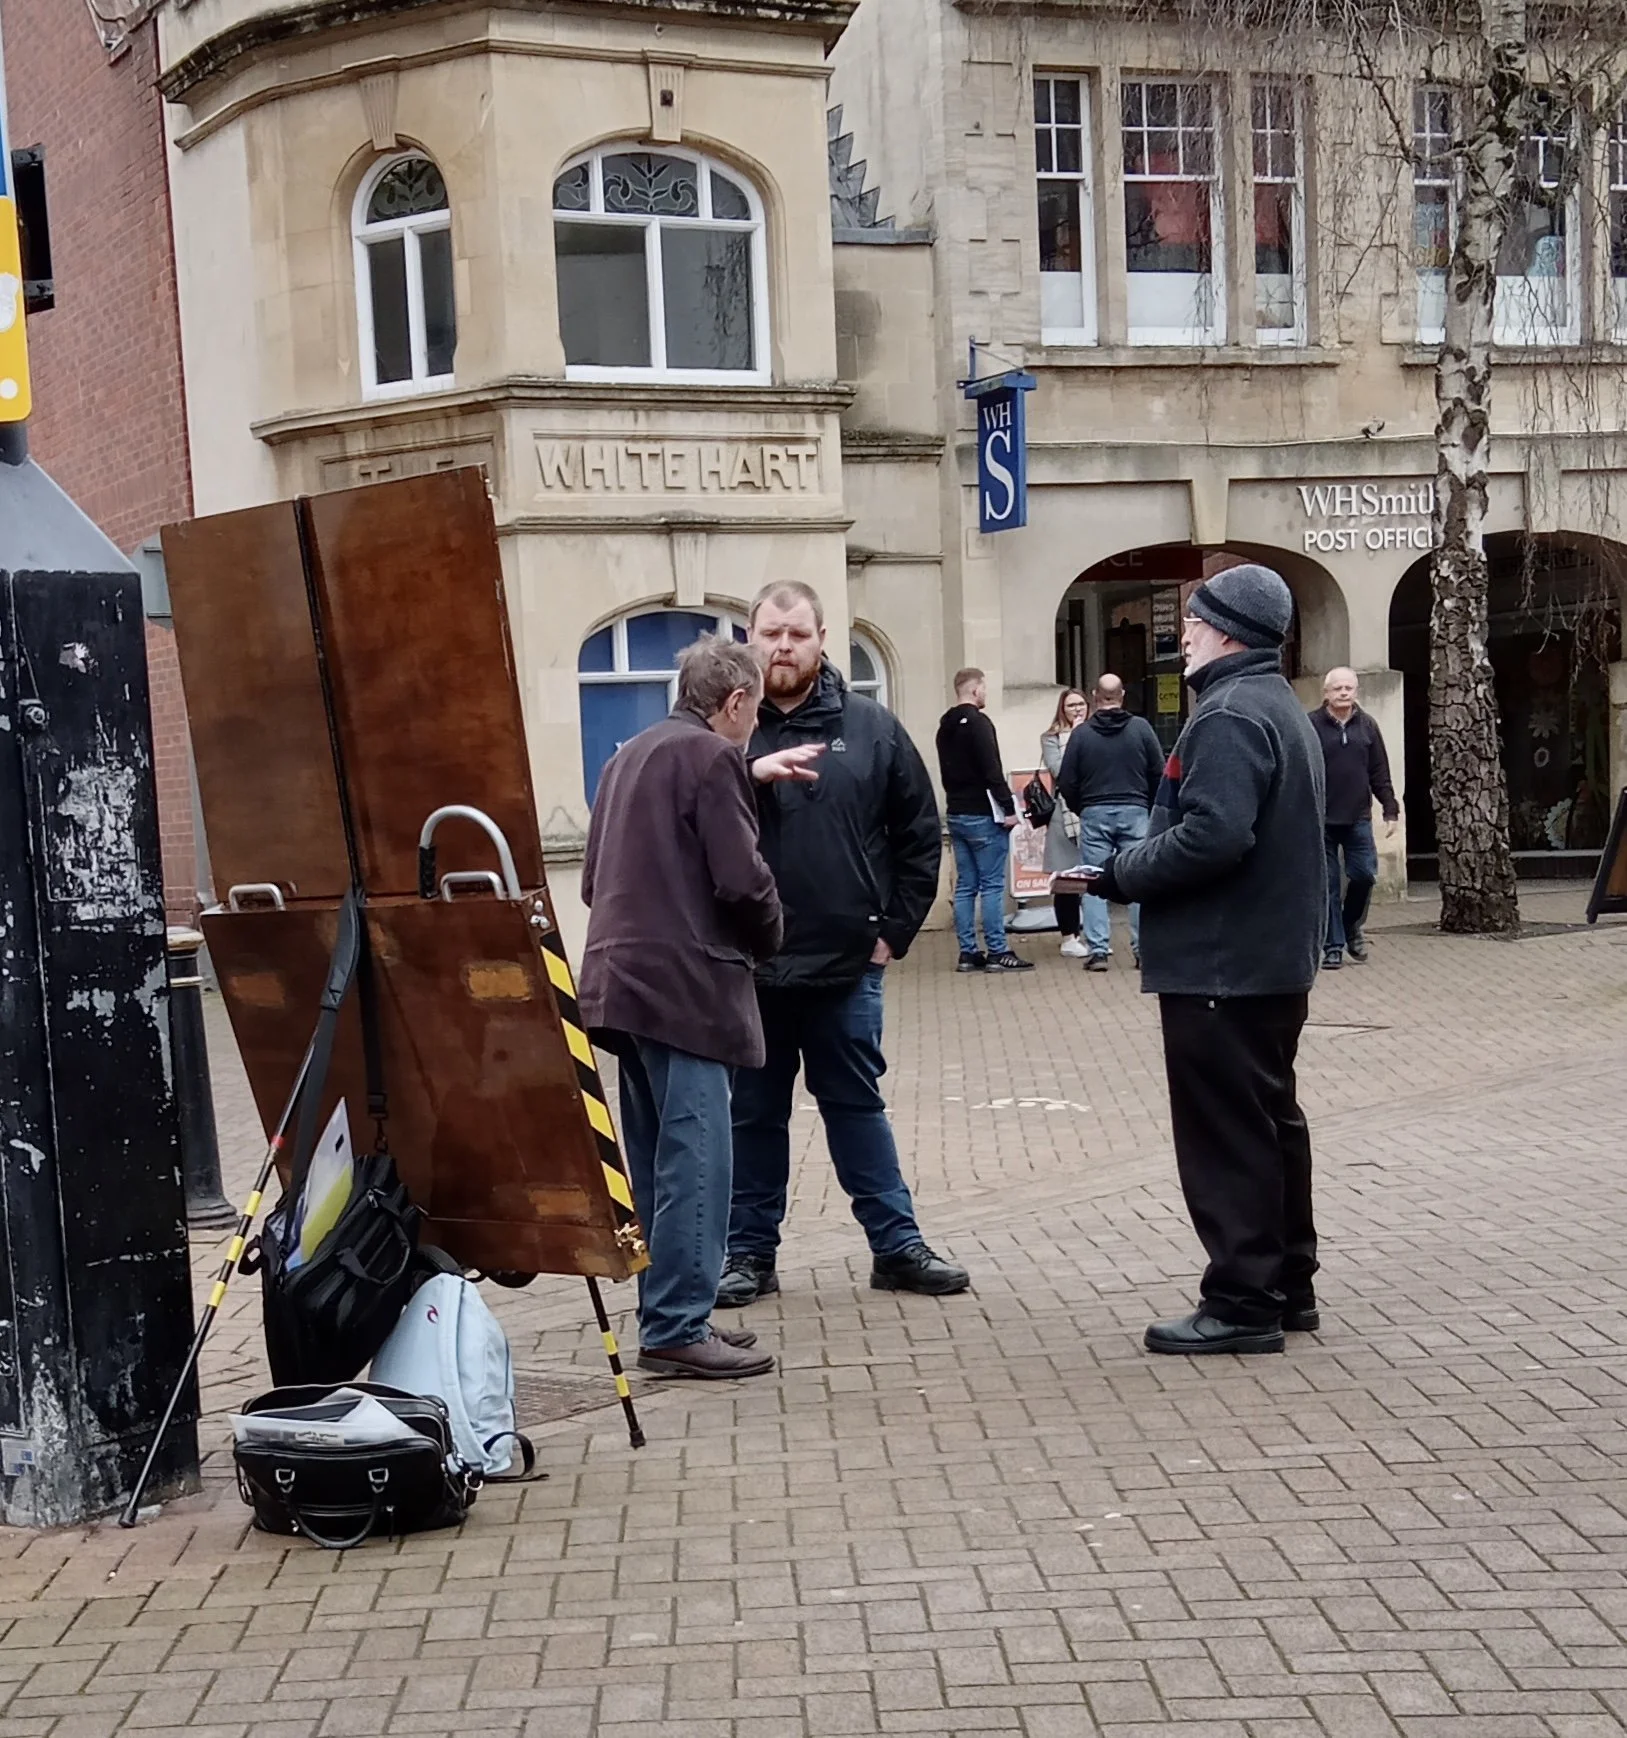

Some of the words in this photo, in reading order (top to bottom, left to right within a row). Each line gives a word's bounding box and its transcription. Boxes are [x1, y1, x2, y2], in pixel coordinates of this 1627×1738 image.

[983, 401, 1012, 430] WH
[535, 443, 688, 489] WHITE
[699, 444, 818, 490] HART
[985, 429, 1015, 521] S
[1304, 528, 1359, 552] POST
[1032, 878, 1050, 888] SAL
